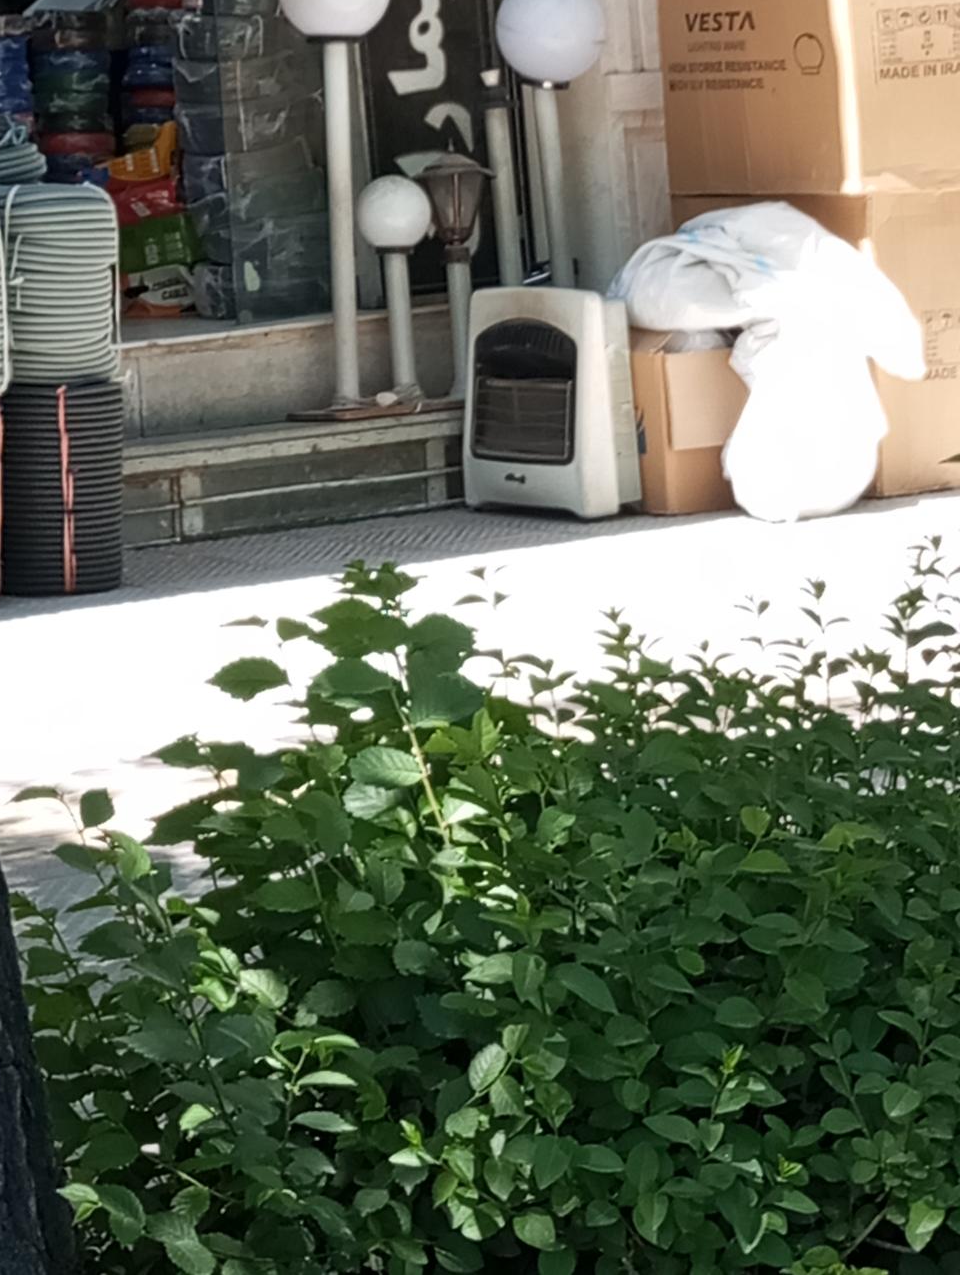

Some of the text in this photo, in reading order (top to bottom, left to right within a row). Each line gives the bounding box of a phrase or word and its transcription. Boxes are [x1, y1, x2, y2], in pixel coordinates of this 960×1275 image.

[685, 10, 755, 32] VESTA
[880, 66, 920, 79] MADE
[923, 64, 937, 77] IN
